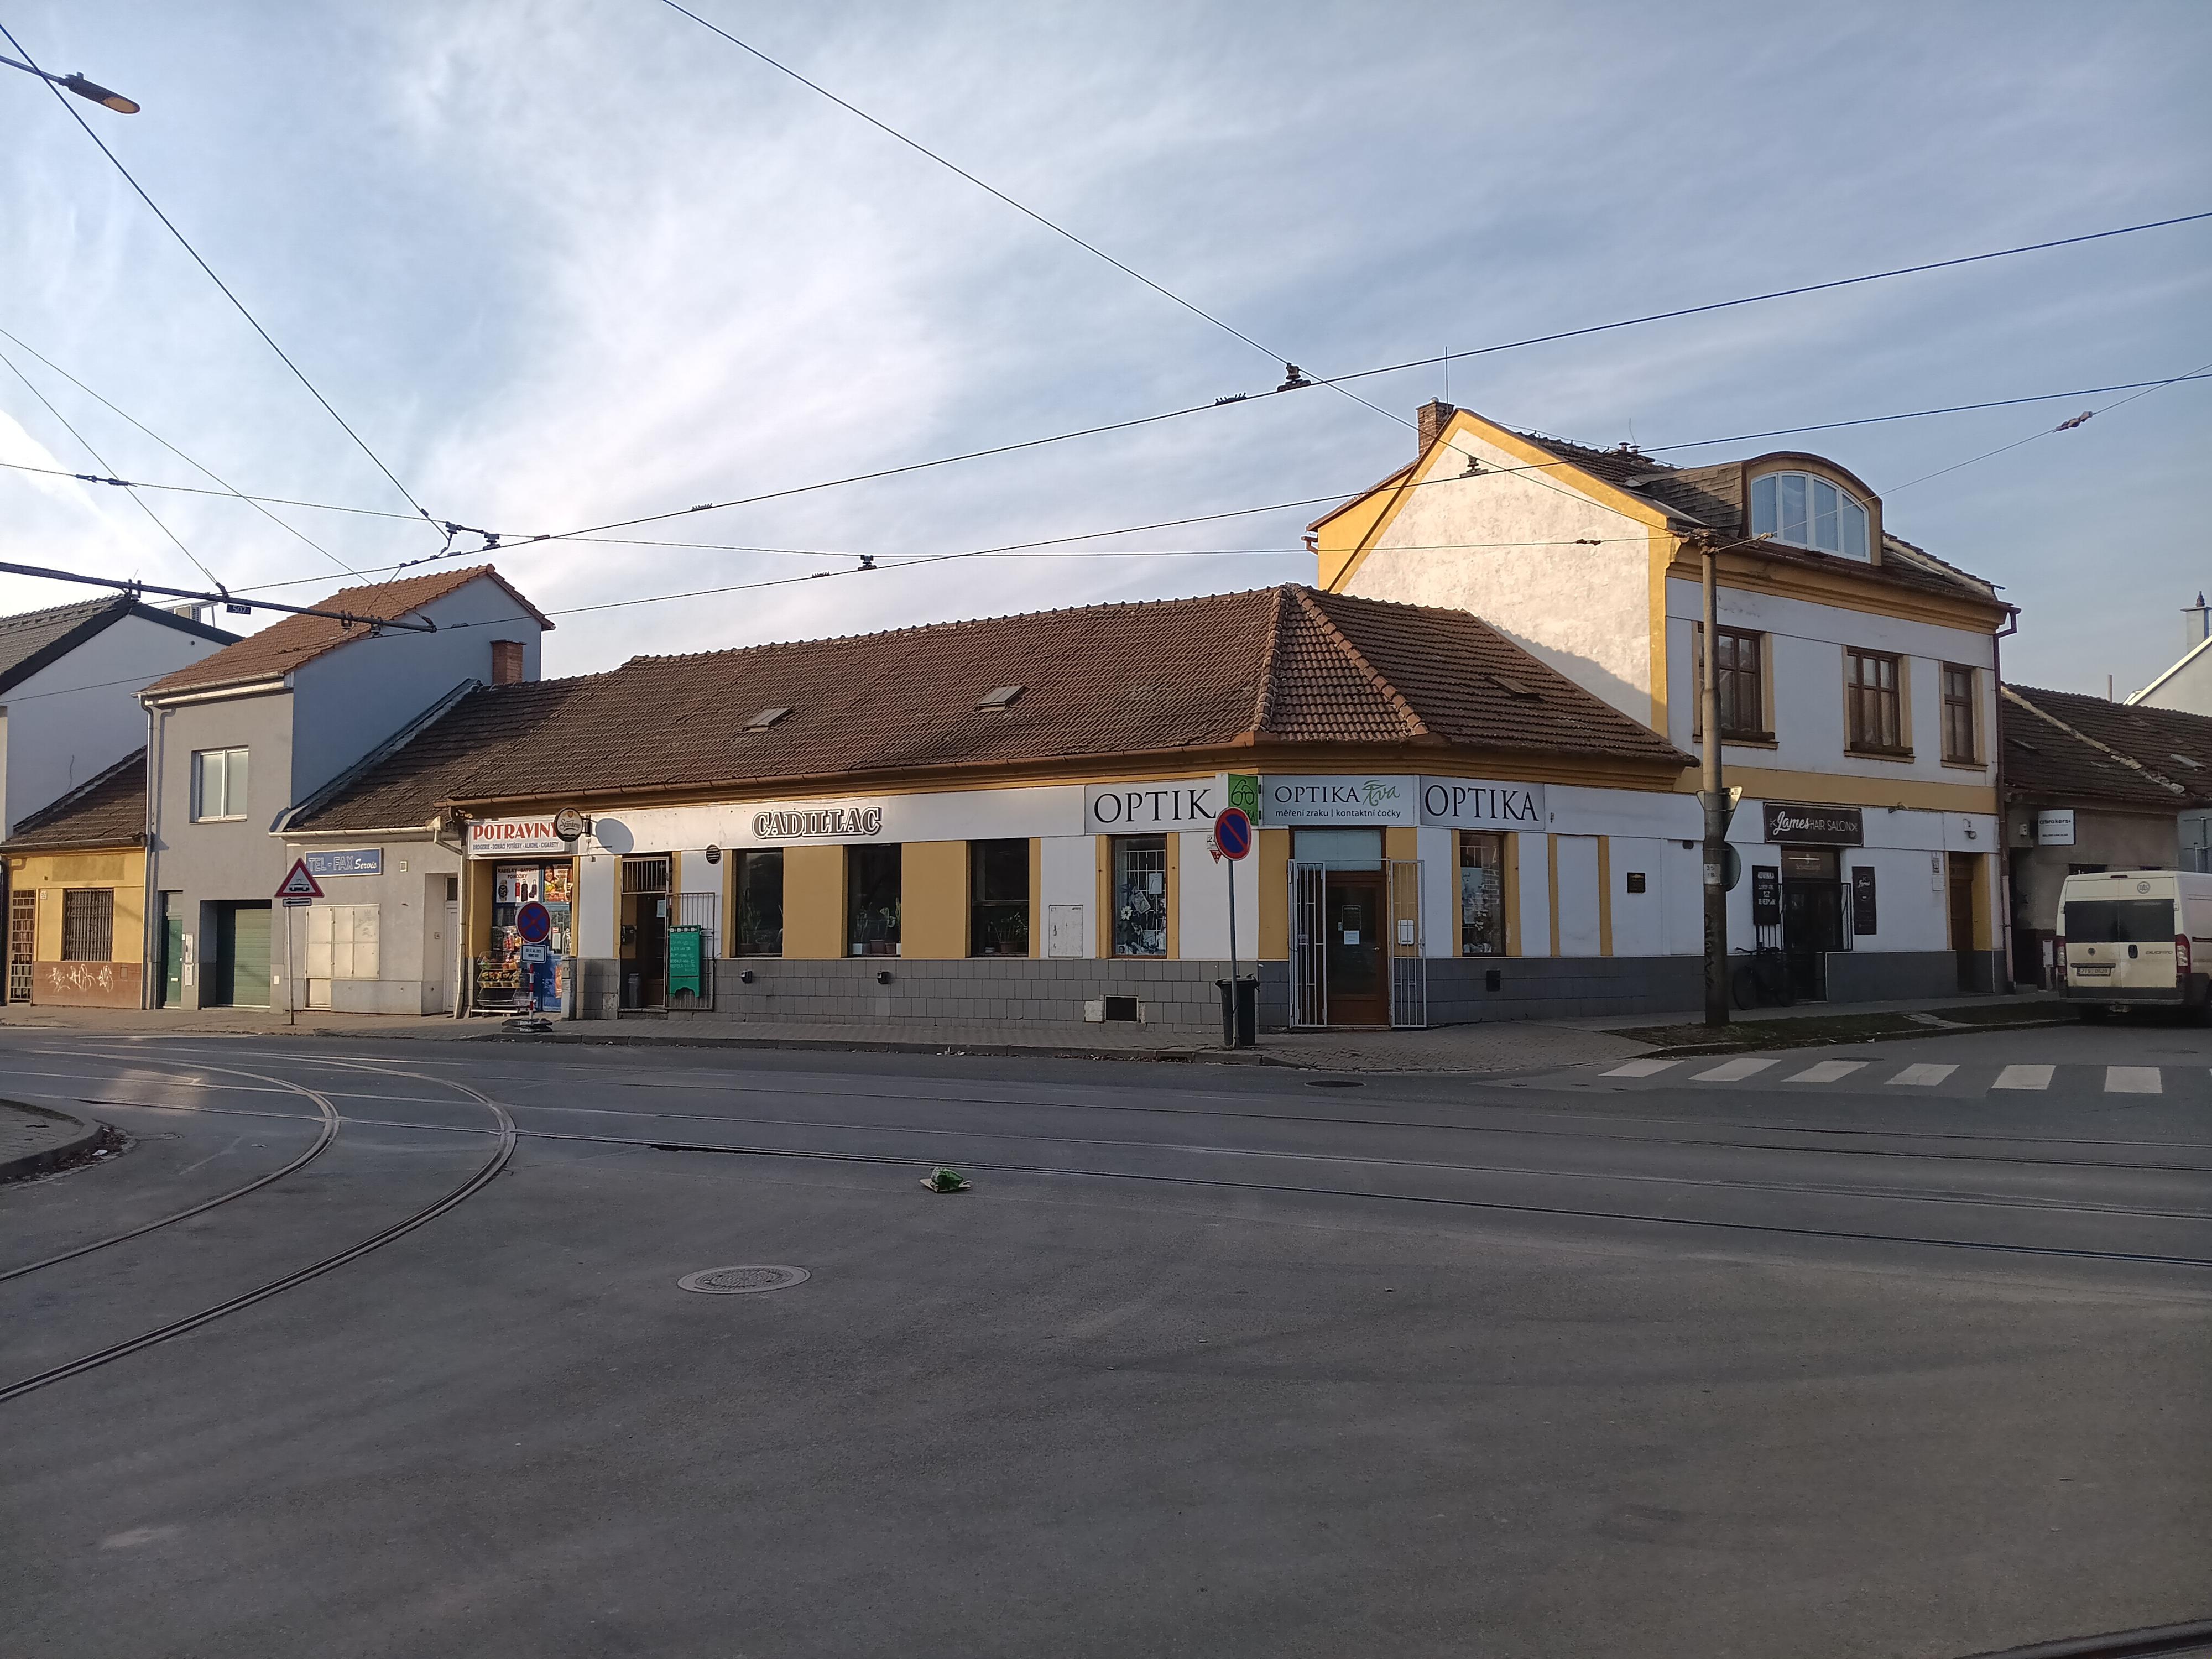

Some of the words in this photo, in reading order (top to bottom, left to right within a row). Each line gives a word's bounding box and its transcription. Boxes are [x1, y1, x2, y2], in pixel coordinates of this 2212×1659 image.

[1094, 789, 1216, 823] OPTIK
[1275, 786, 1361, 802] OPTIKA
[1425, 785, 1540, 821] OPTIKA
[752, 806, 883, 839] CADILLAC
[1336, 808, 1375, 817] kontaktní
[1377, 809, 1401, 818] čočky
[1773, 811, 1810, 836] James
[1827, 820, 1853, 832] SALON
[308, 857, 327, 872] TEL
[333, 856, 353, 870] FAX
[354, 858, 377, 870] Servis
